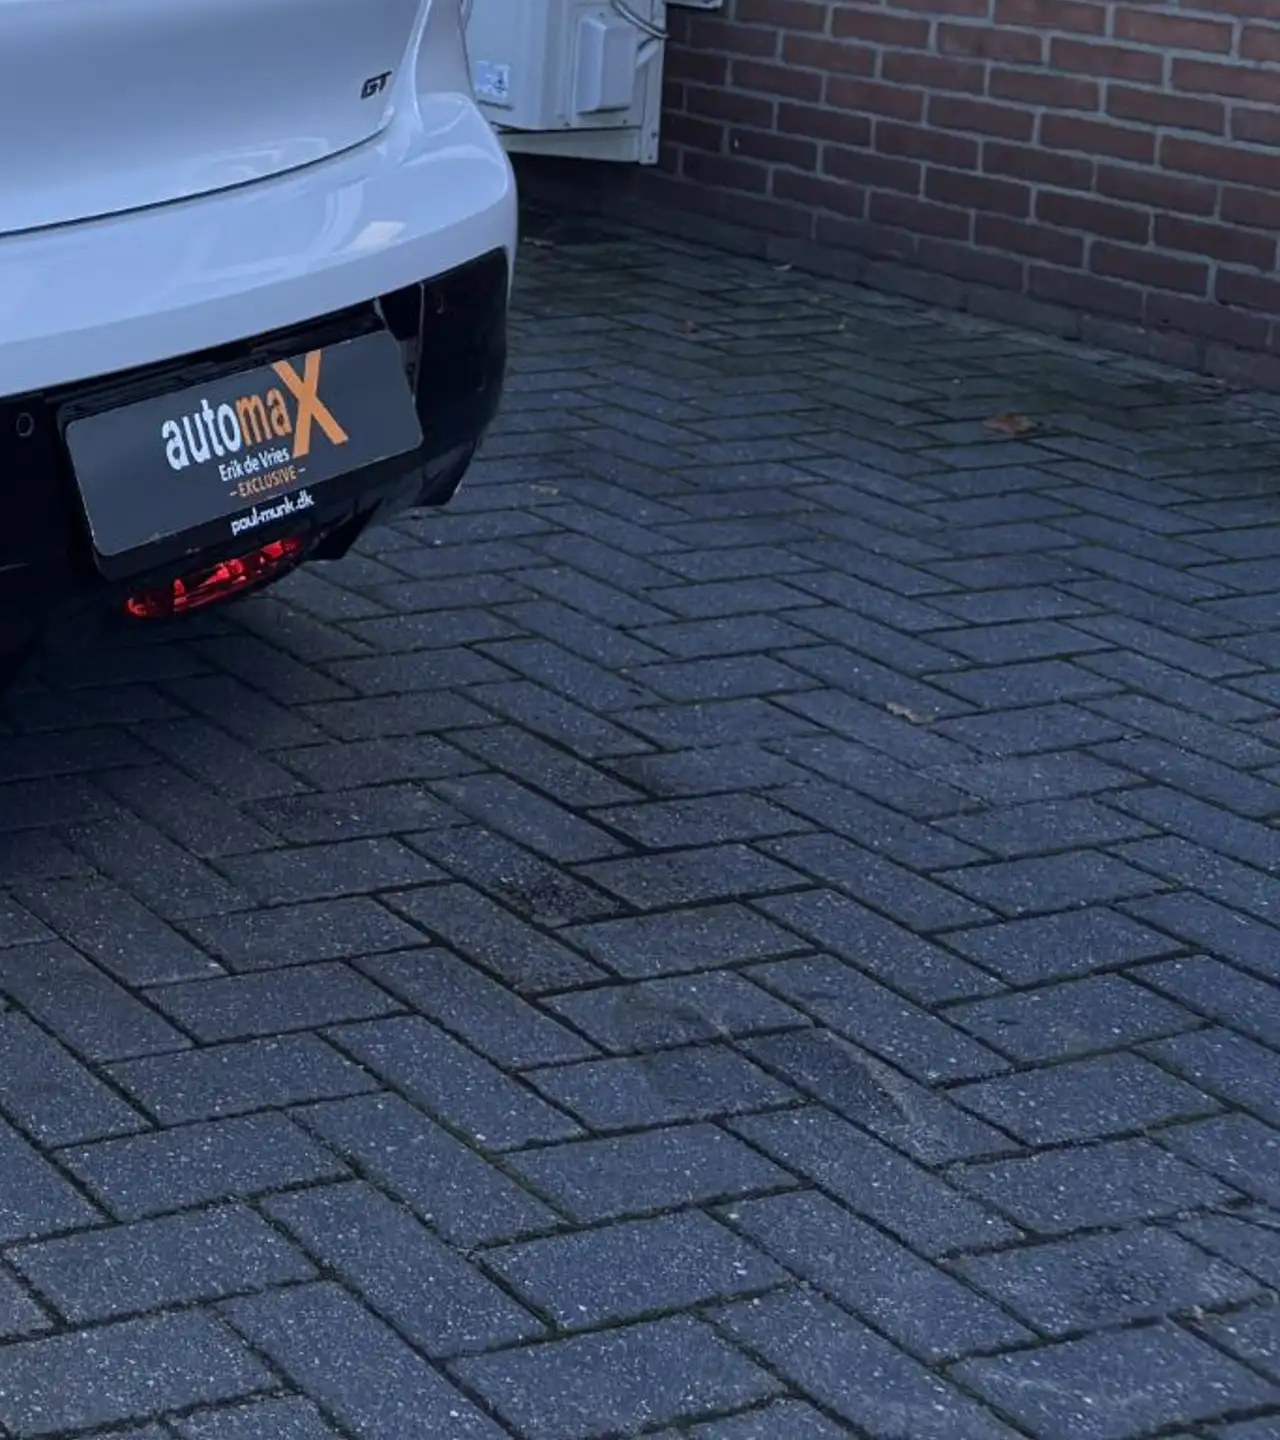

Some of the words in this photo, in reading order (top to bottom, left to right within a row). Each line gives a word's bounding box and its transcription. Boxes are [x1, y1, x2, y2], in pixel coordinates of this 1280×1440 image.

[360, 70, 393, 100] GT
[218, 460, 245, 482] Erik
[243, 454, 260, 475] de
[258, 446, 290, 468] Vries
